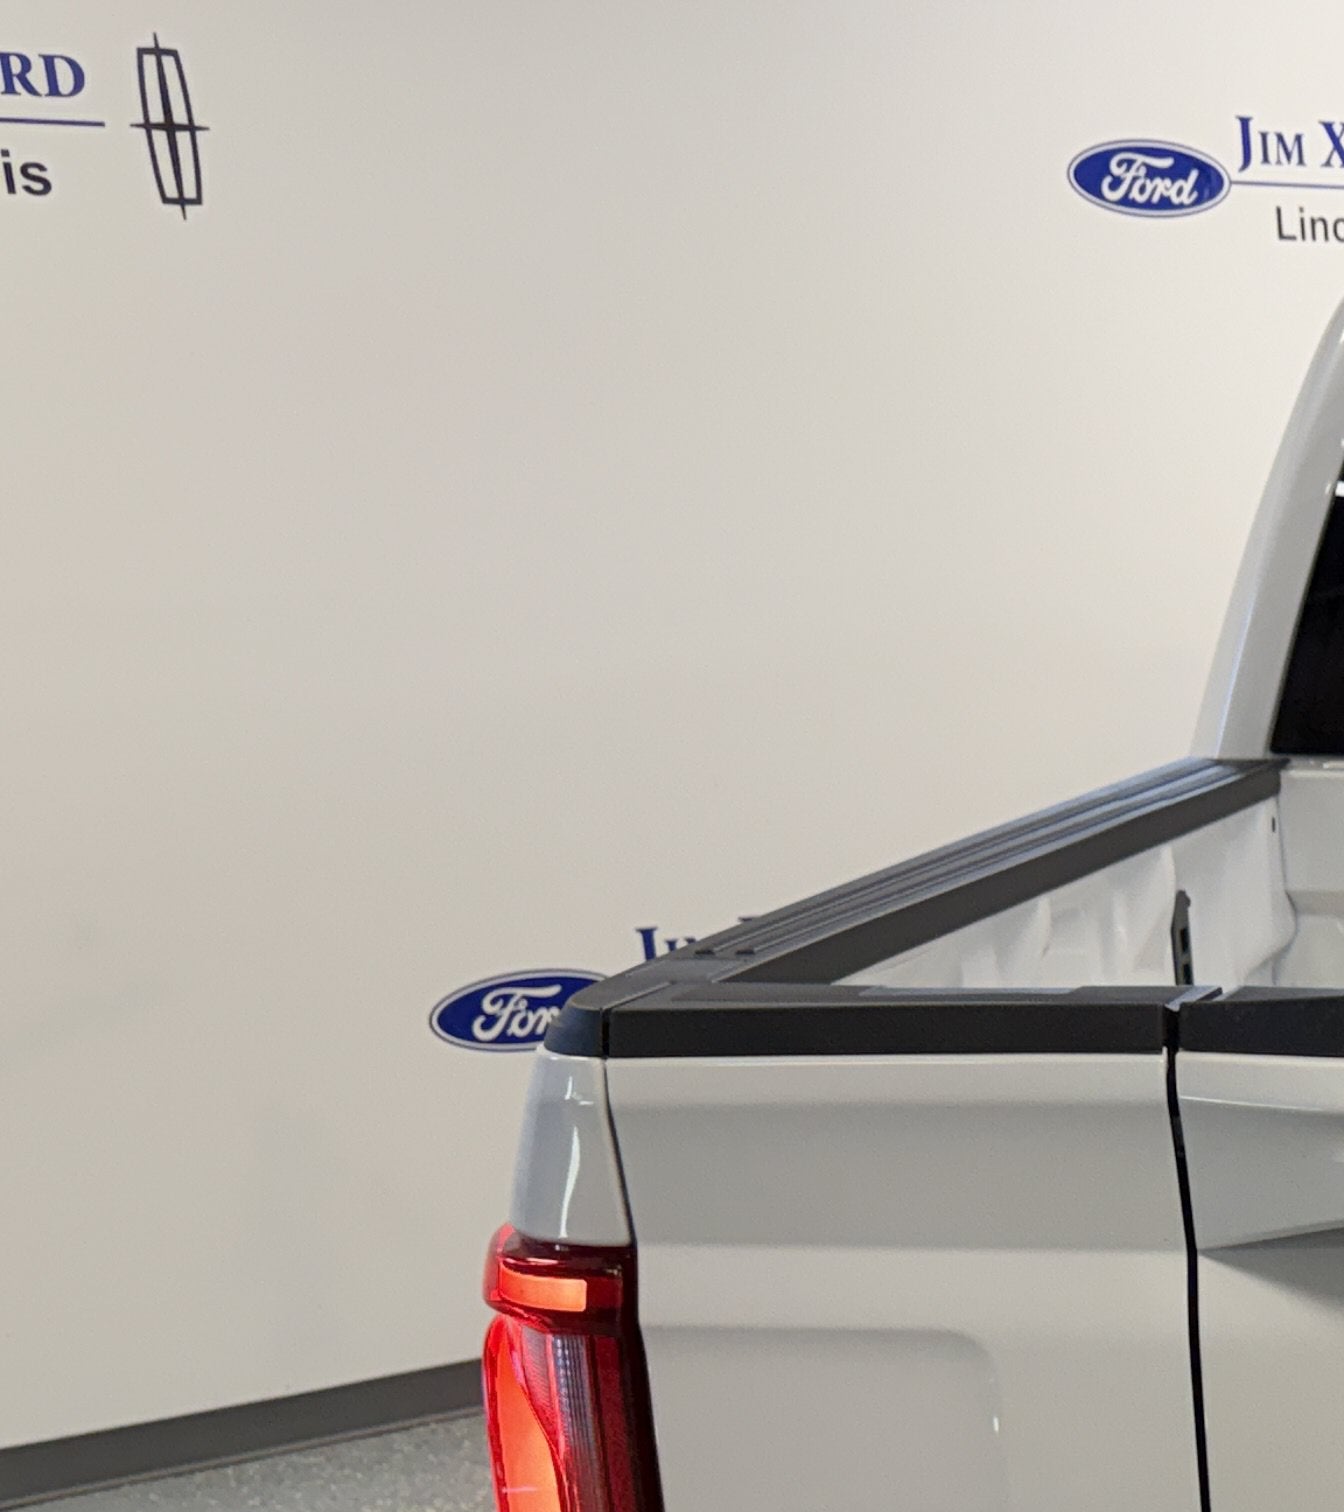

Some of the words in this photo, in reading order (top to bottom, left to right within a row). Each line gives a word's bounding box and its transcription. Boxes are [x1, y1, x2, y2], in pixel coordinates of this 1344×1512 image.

[1235, 115, 1306, 173] JIM
[1101, 152, 1199, 207] Ford
[471, 983, 562, 1042] For
